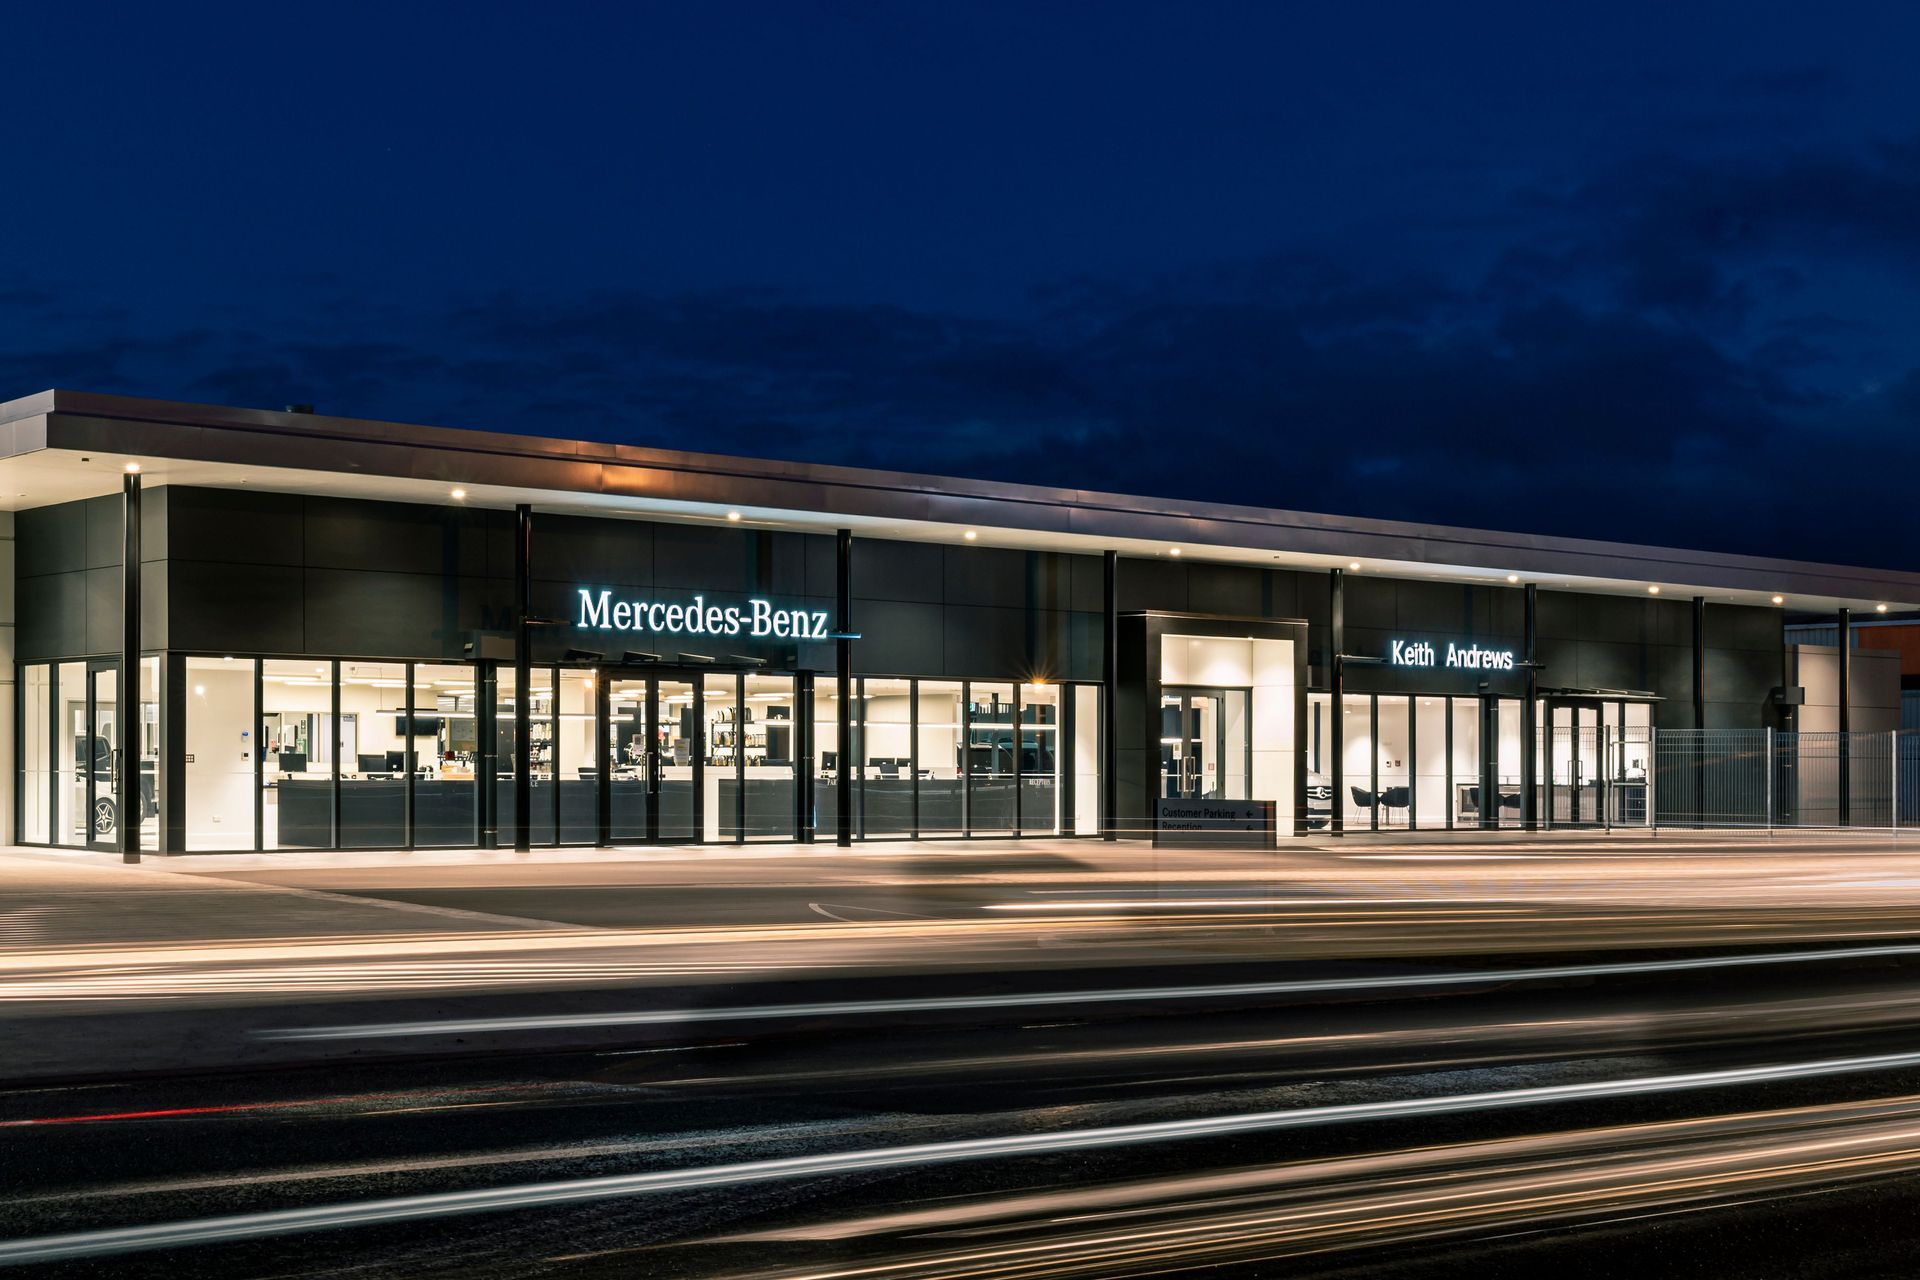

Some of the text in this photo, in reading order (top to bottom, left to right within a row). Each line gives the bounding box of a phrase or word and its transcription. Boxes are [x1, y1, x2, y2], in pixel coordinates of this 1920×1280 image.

[577, 589, 828, 639] Mercedes-Benz
[1392, 640, 1514, 670] Keith Andrews
[1162, 807, 1236, 822] Customer Parking
[1162, 821, 1203, 833] Reception
